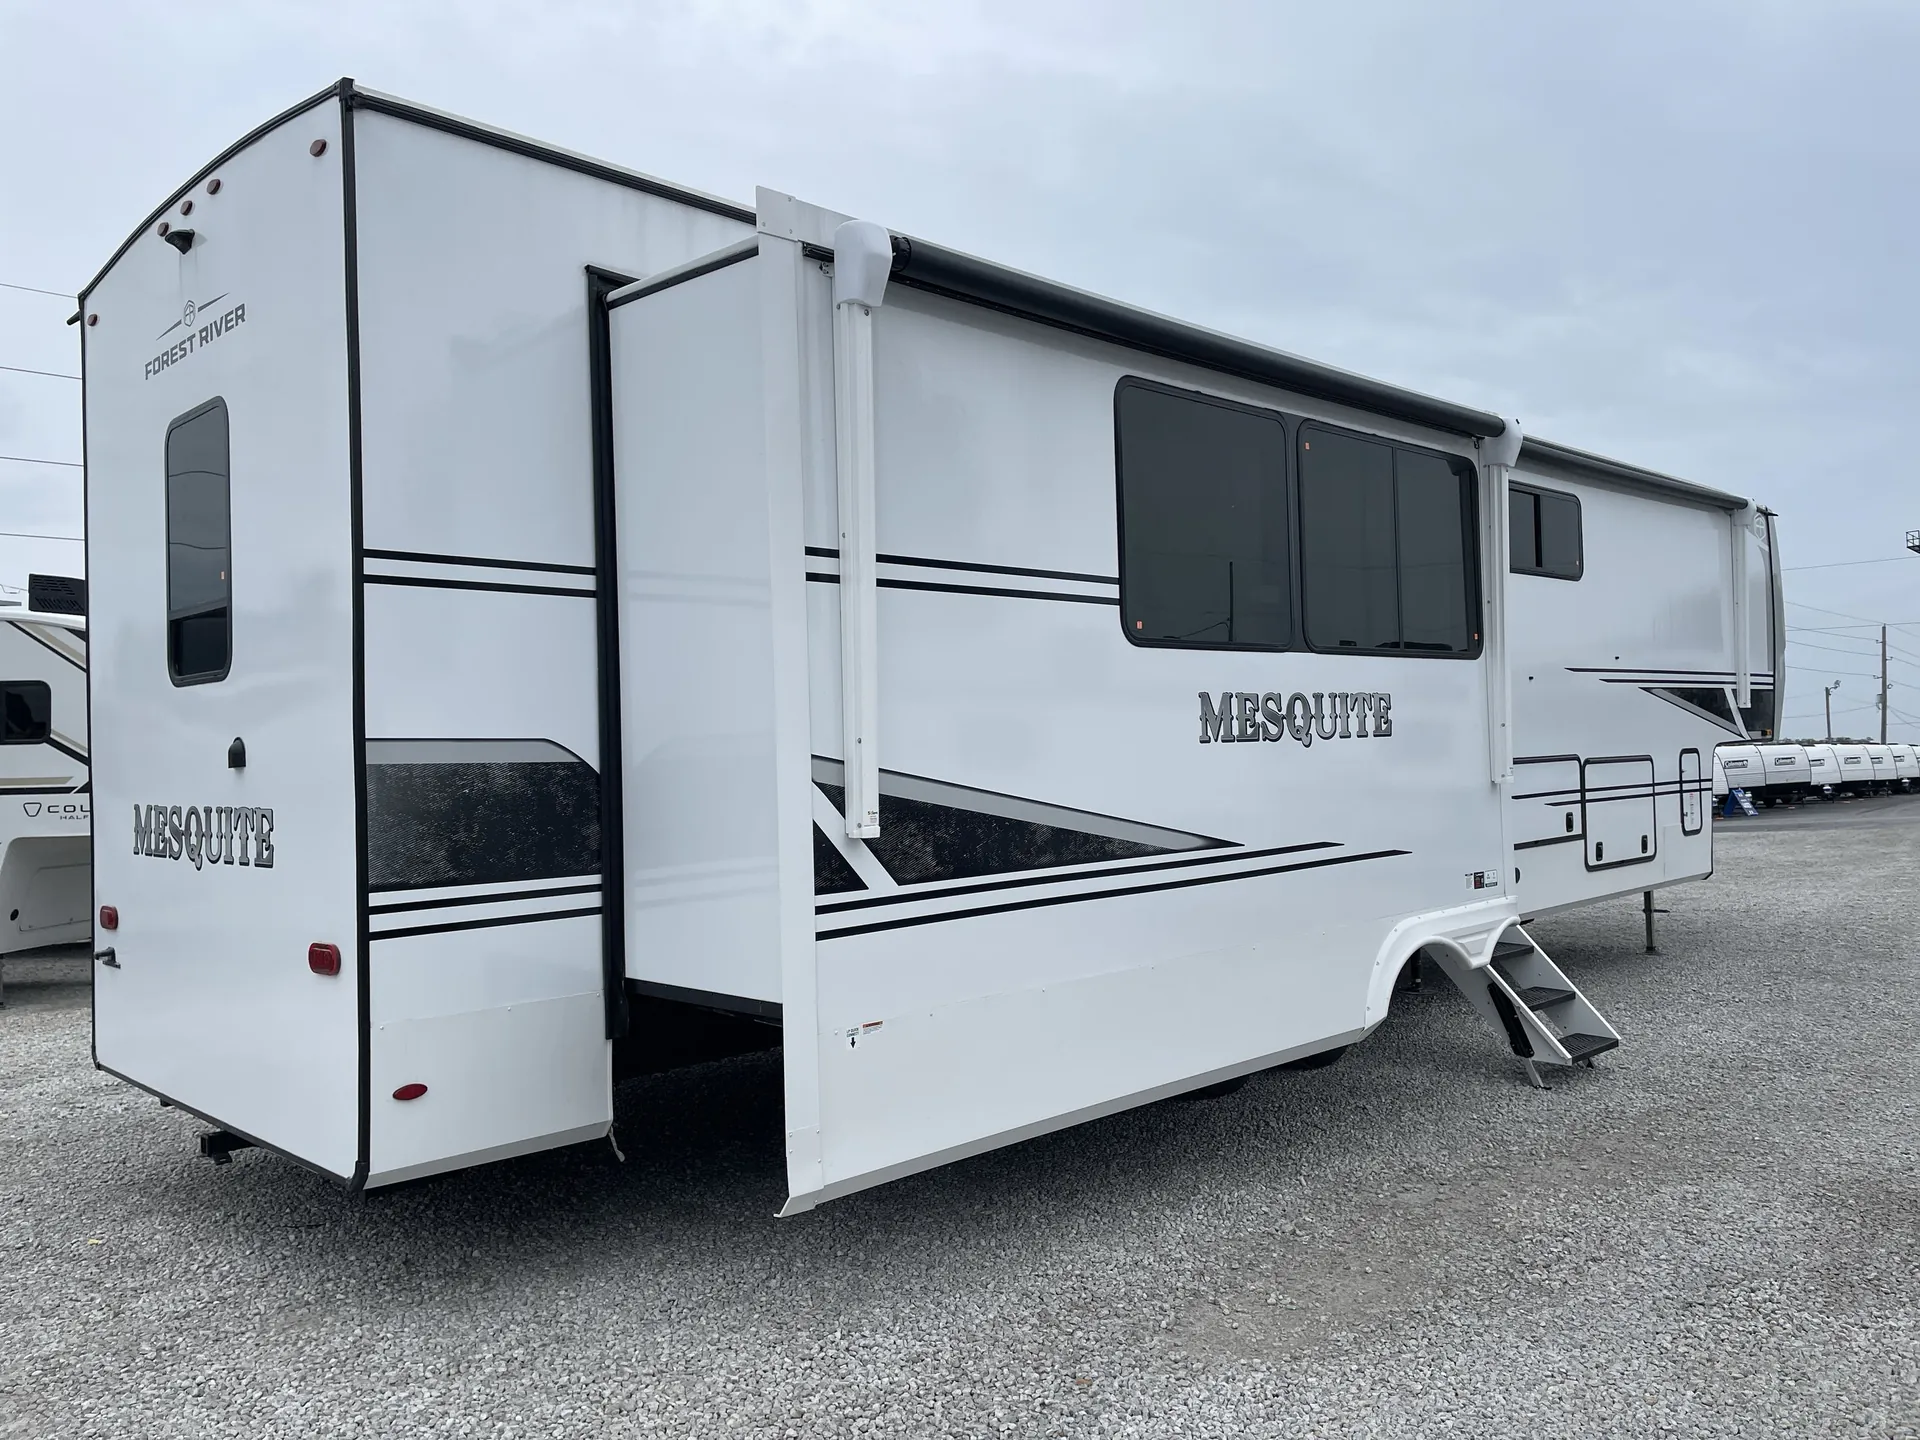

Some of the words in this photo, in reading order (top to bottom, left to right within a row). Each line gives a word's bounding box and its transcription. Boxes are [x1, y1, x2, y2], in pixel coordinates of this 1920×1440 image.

[145, 332, 196, 380] FOREST
[198, 303, 246, 348] RIVER
[1198, 691, 1392, 748] MESQUITE
[133, 804, 274, 871] MESQUITE
